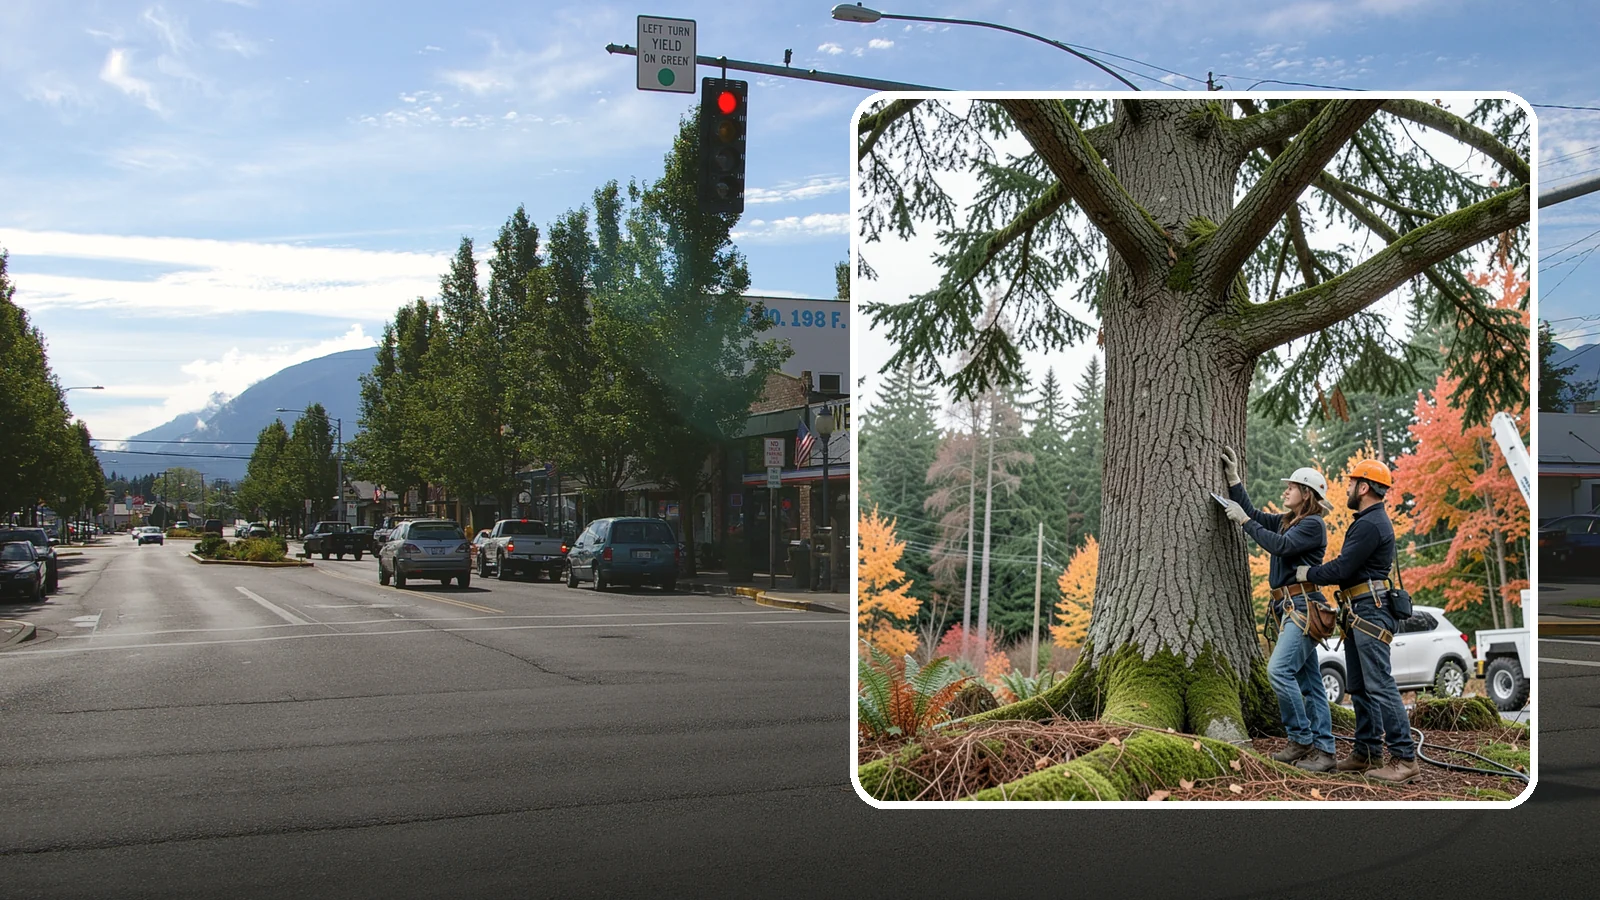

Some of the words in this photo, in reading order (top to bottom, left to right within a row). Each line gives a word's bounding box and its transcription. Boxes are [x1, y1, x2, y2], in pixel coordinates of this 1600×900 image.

[643, 23, 663, 34] LEFT
[668, 26, 690, 36] TURN
[652, 38, 682, 51] YIELD
[644, 53, 656, 63] ON
[661, 54, 688, 66] GREEN
[791, 309, 826, 328] 198
[831, 311, 846, 329] F.
